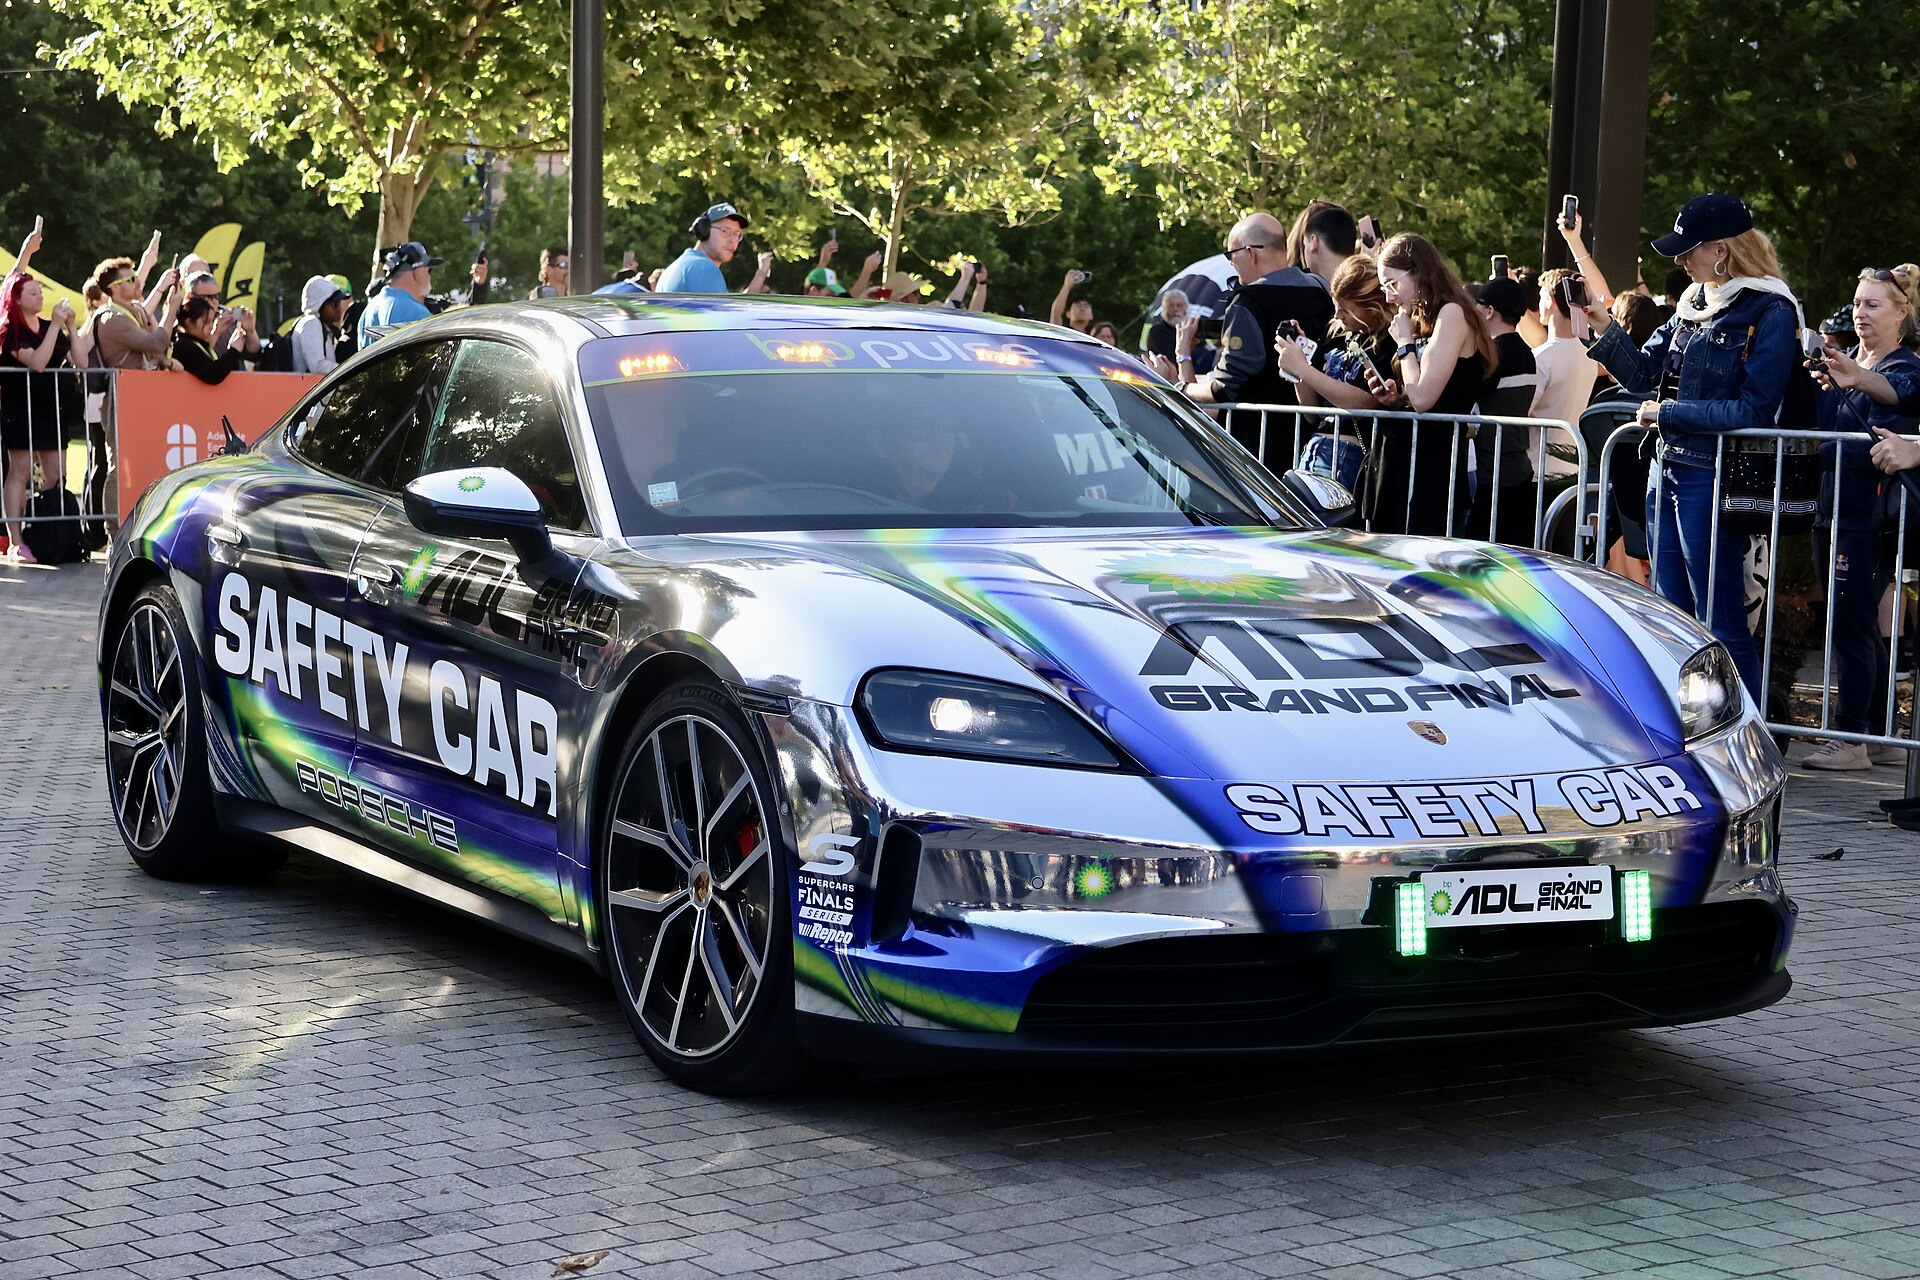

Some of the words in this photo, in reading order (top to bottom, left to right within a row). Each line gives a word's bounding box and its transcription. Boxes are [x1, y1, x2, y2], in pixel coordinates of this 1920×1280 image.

[860, 335, 1045, 369] pulse
[418, 550, 522, 641] ADL
[1138, 613, 1547, 680] ADL
[215, 572, 409, 747] SAFETY
[430, 660, 558, 818] CAR
[1148, 685, 1408, 715] GRAND
[1404, 673, 1582, 712] FINAL
[295, 758, 460, 856] PORSCHE
[1223, 779, 1547, 838] SAFETY
[1557, 763, 1703, 827] CAR
[798, 876, 855, 892] SUPERCARS
[798, 887, 854, 911] FINALS
[1451, 884, 1534, 916] ADL
[1538, 880, 1602, 896] GRAND
[807, 908, 843, 922] SERIES
[1537, 894, 1592, 912] FINAL
[810, 922, 854, 945] Repco
